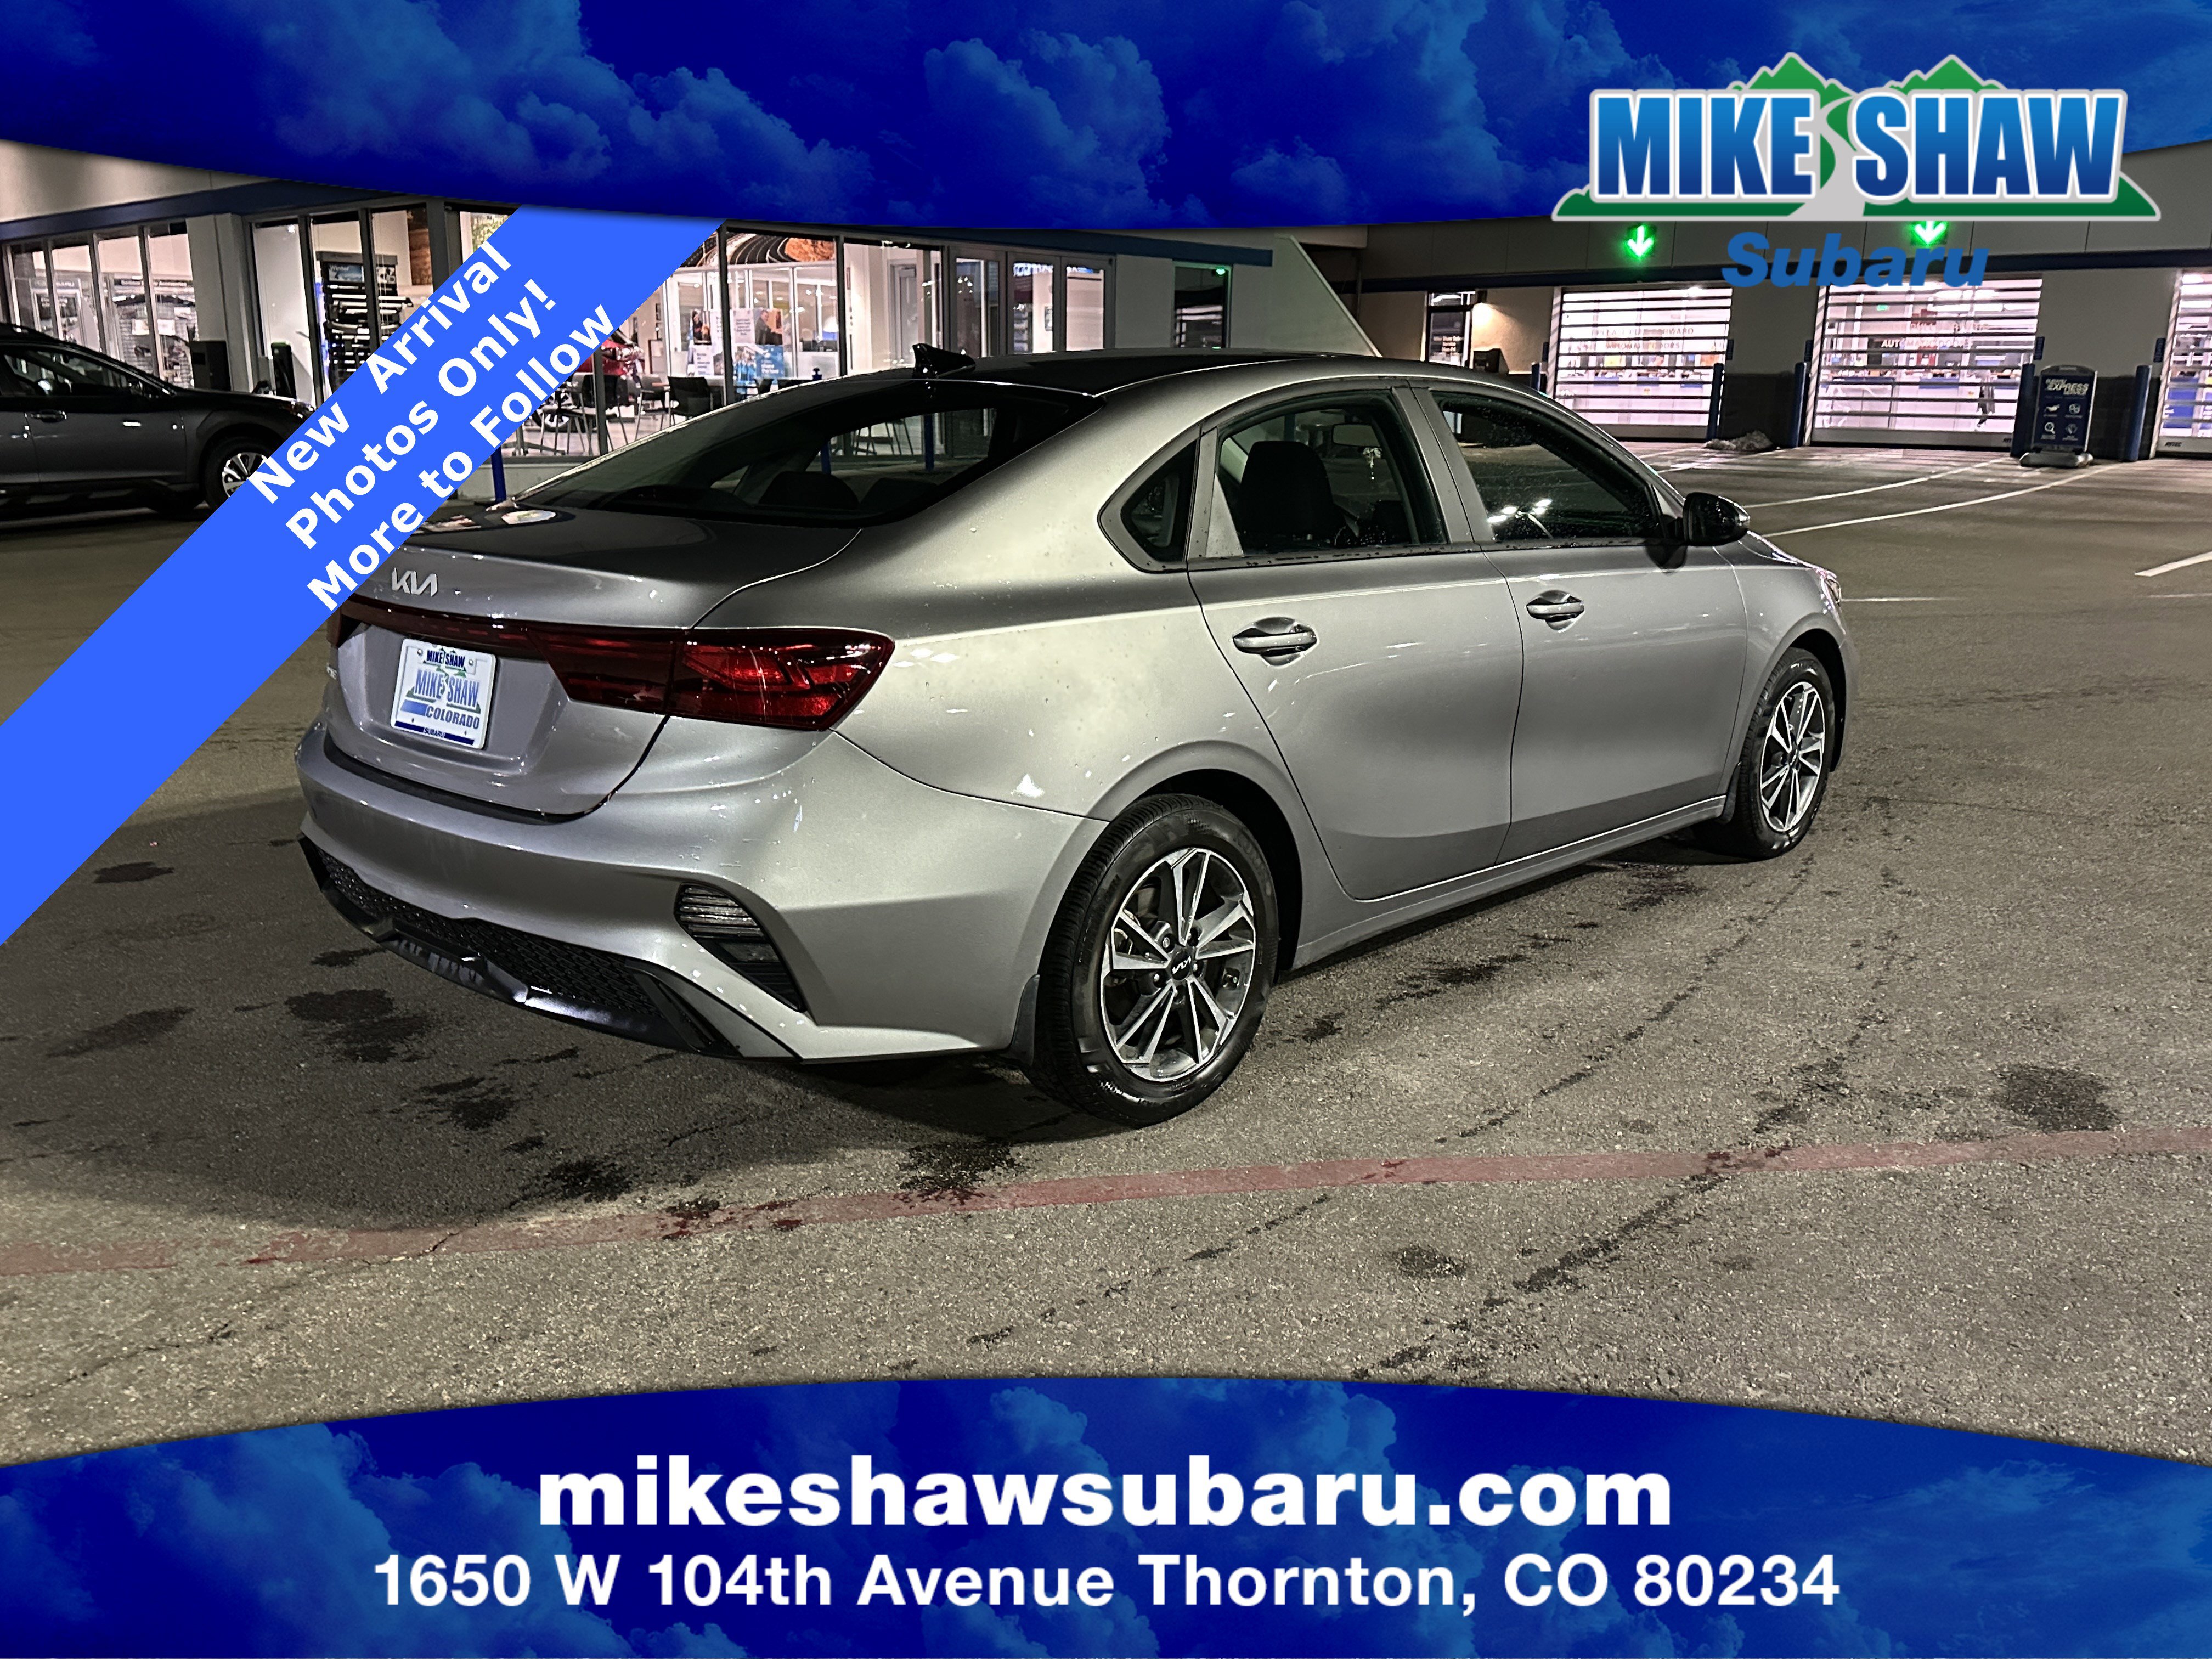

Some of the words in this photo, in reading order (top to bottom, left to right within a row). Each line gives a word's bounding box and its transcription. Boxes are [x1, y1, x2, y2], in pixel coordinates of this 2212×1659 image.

[391, 567, 438, 597] KIA
[427, 649, 443, 664] MIKE
[445, 654, 465, 668] SHAW
[415, 669, 444, 699] MIKE
[447, 676, 479, 707] SHAW
[426, 706, 480, 730] COLORADO
